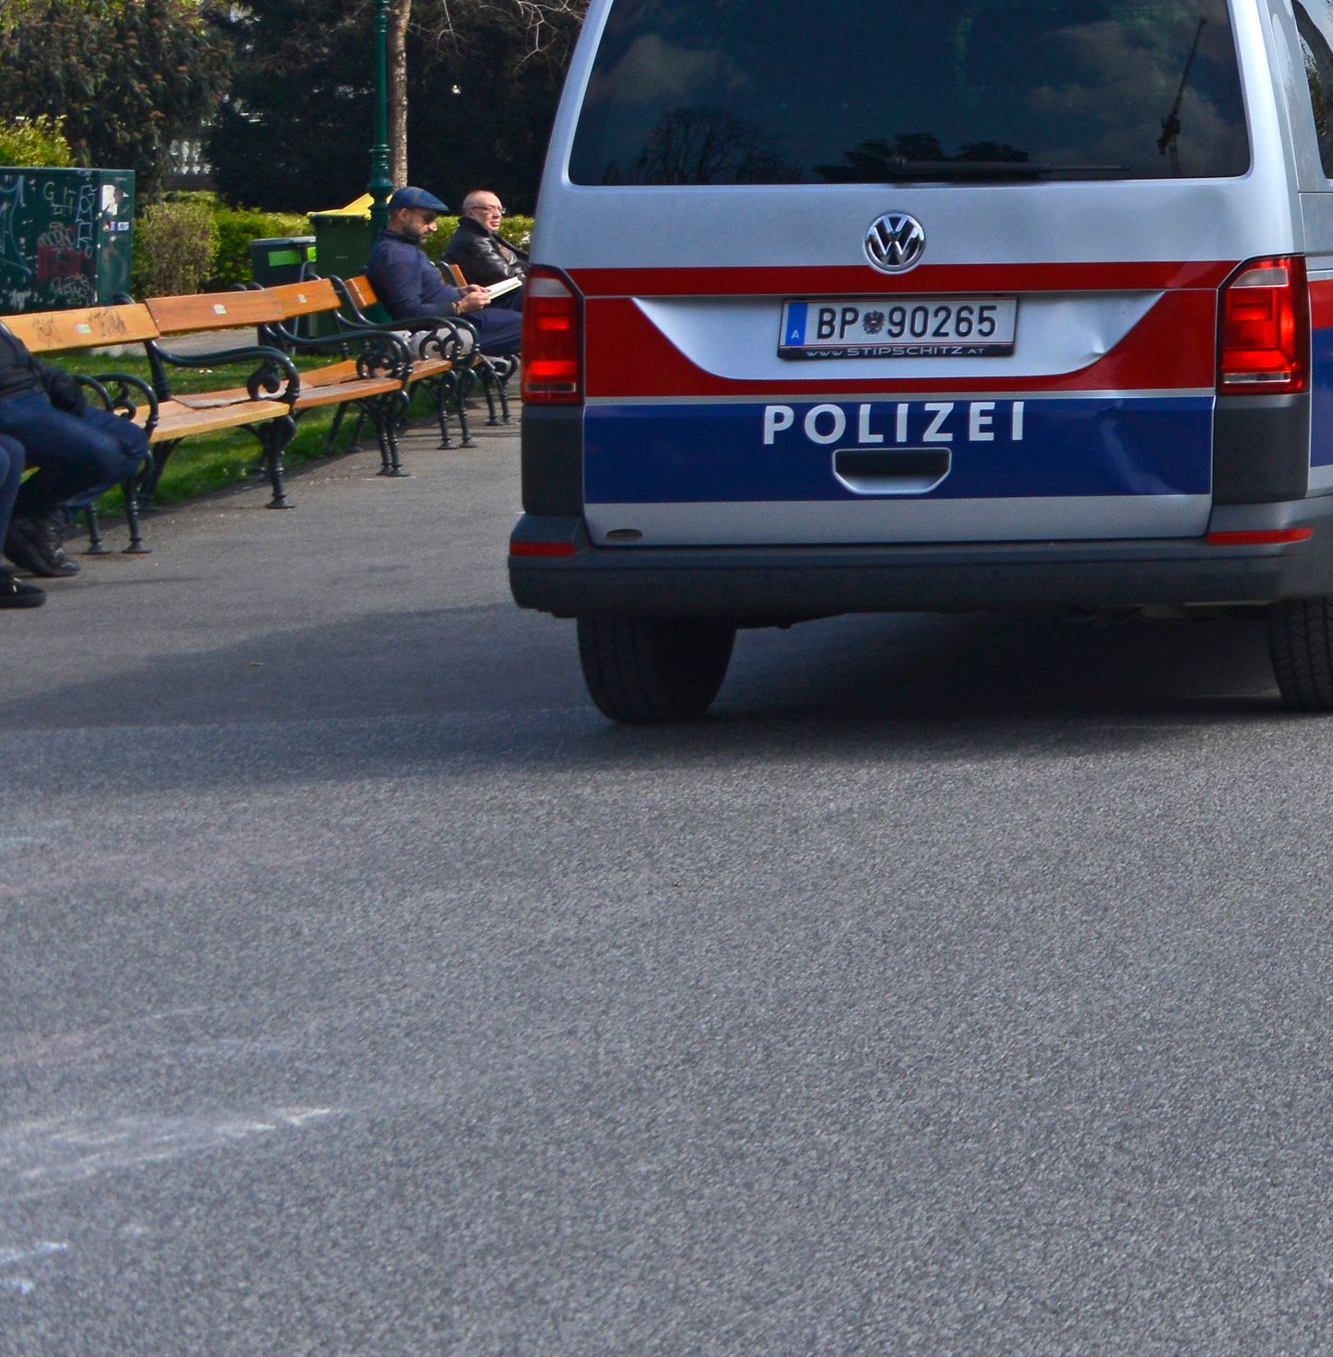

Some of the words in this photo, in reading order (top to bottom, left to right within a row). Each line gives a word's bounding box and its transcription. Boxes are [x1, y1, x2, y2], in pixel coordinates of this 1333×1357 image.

[863, 212, 925, 273] VW
[790, 329, 801, 340] A
[817, 307, 859, 340] BP
[887, 305, 998, 339] 90265
[763, 400, 1025, 445] POLIZEI
